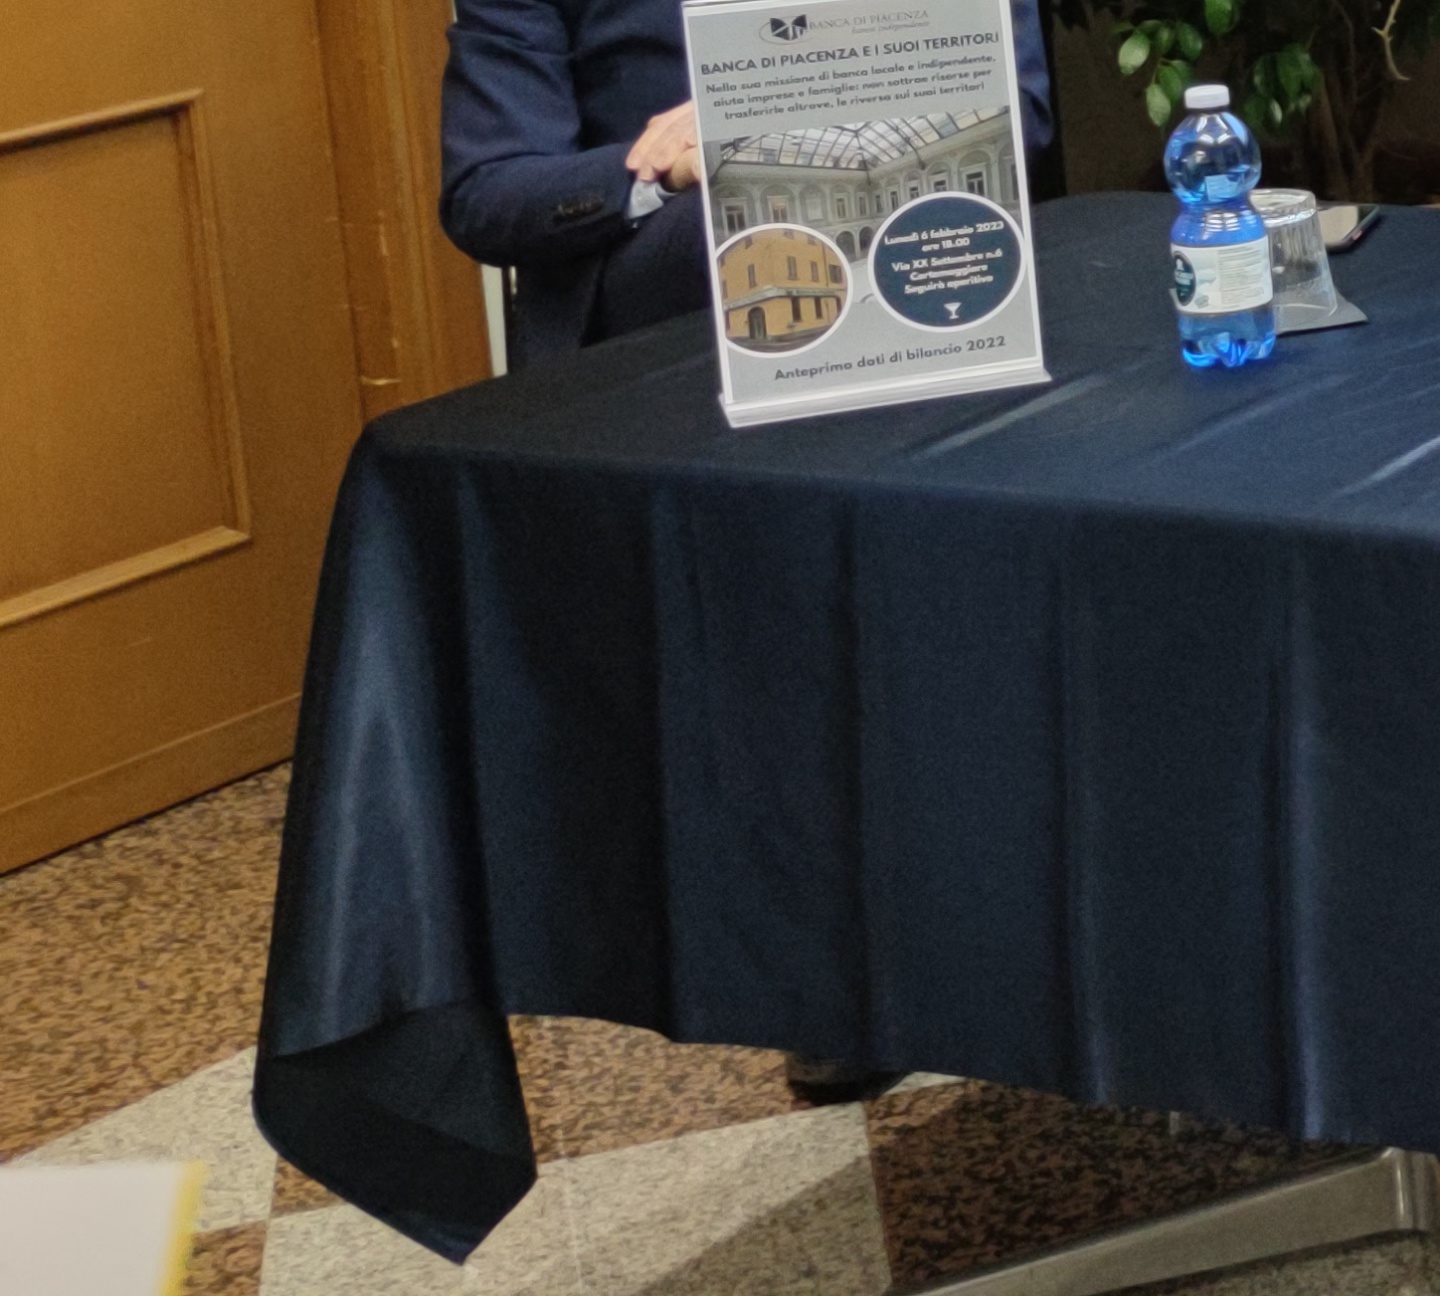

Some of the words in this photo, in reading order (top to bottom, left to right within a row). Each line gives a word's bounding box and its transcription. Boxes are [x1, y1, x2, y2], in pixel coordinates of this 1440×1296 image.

[853, 16, 866, 26] DI
[870, 10, 929, 24] PIACENZA
[701, 59, 756, 75] BANCA
[761, 56, 776, 68] DI
[780, 47, 859, 66] PIACENZA
[863, 46, 871, 56] E
[883, 42, 920, 54] SUOI
[924, 31, 999, 50] TERRITORI
[706, 83, 737, 94] Nella
[764, 76, 815, 87] missione
[818, 71, 830, 80] di
[714, 96, 744, 107] aiuta
[748, 91, 795, 104] imprese
[837, 98, 847, 107] le
[921, 232, 928, 241] 6
[976, 221, 1004, 232] 2023
[775, 361, 853, 381] Anteprima
[857, 355, 885, 369] dati
[890, 352, 902, 363] di
[906, 344, 962, 361] bilancio
[966, 335, 1006, 352] 2022
